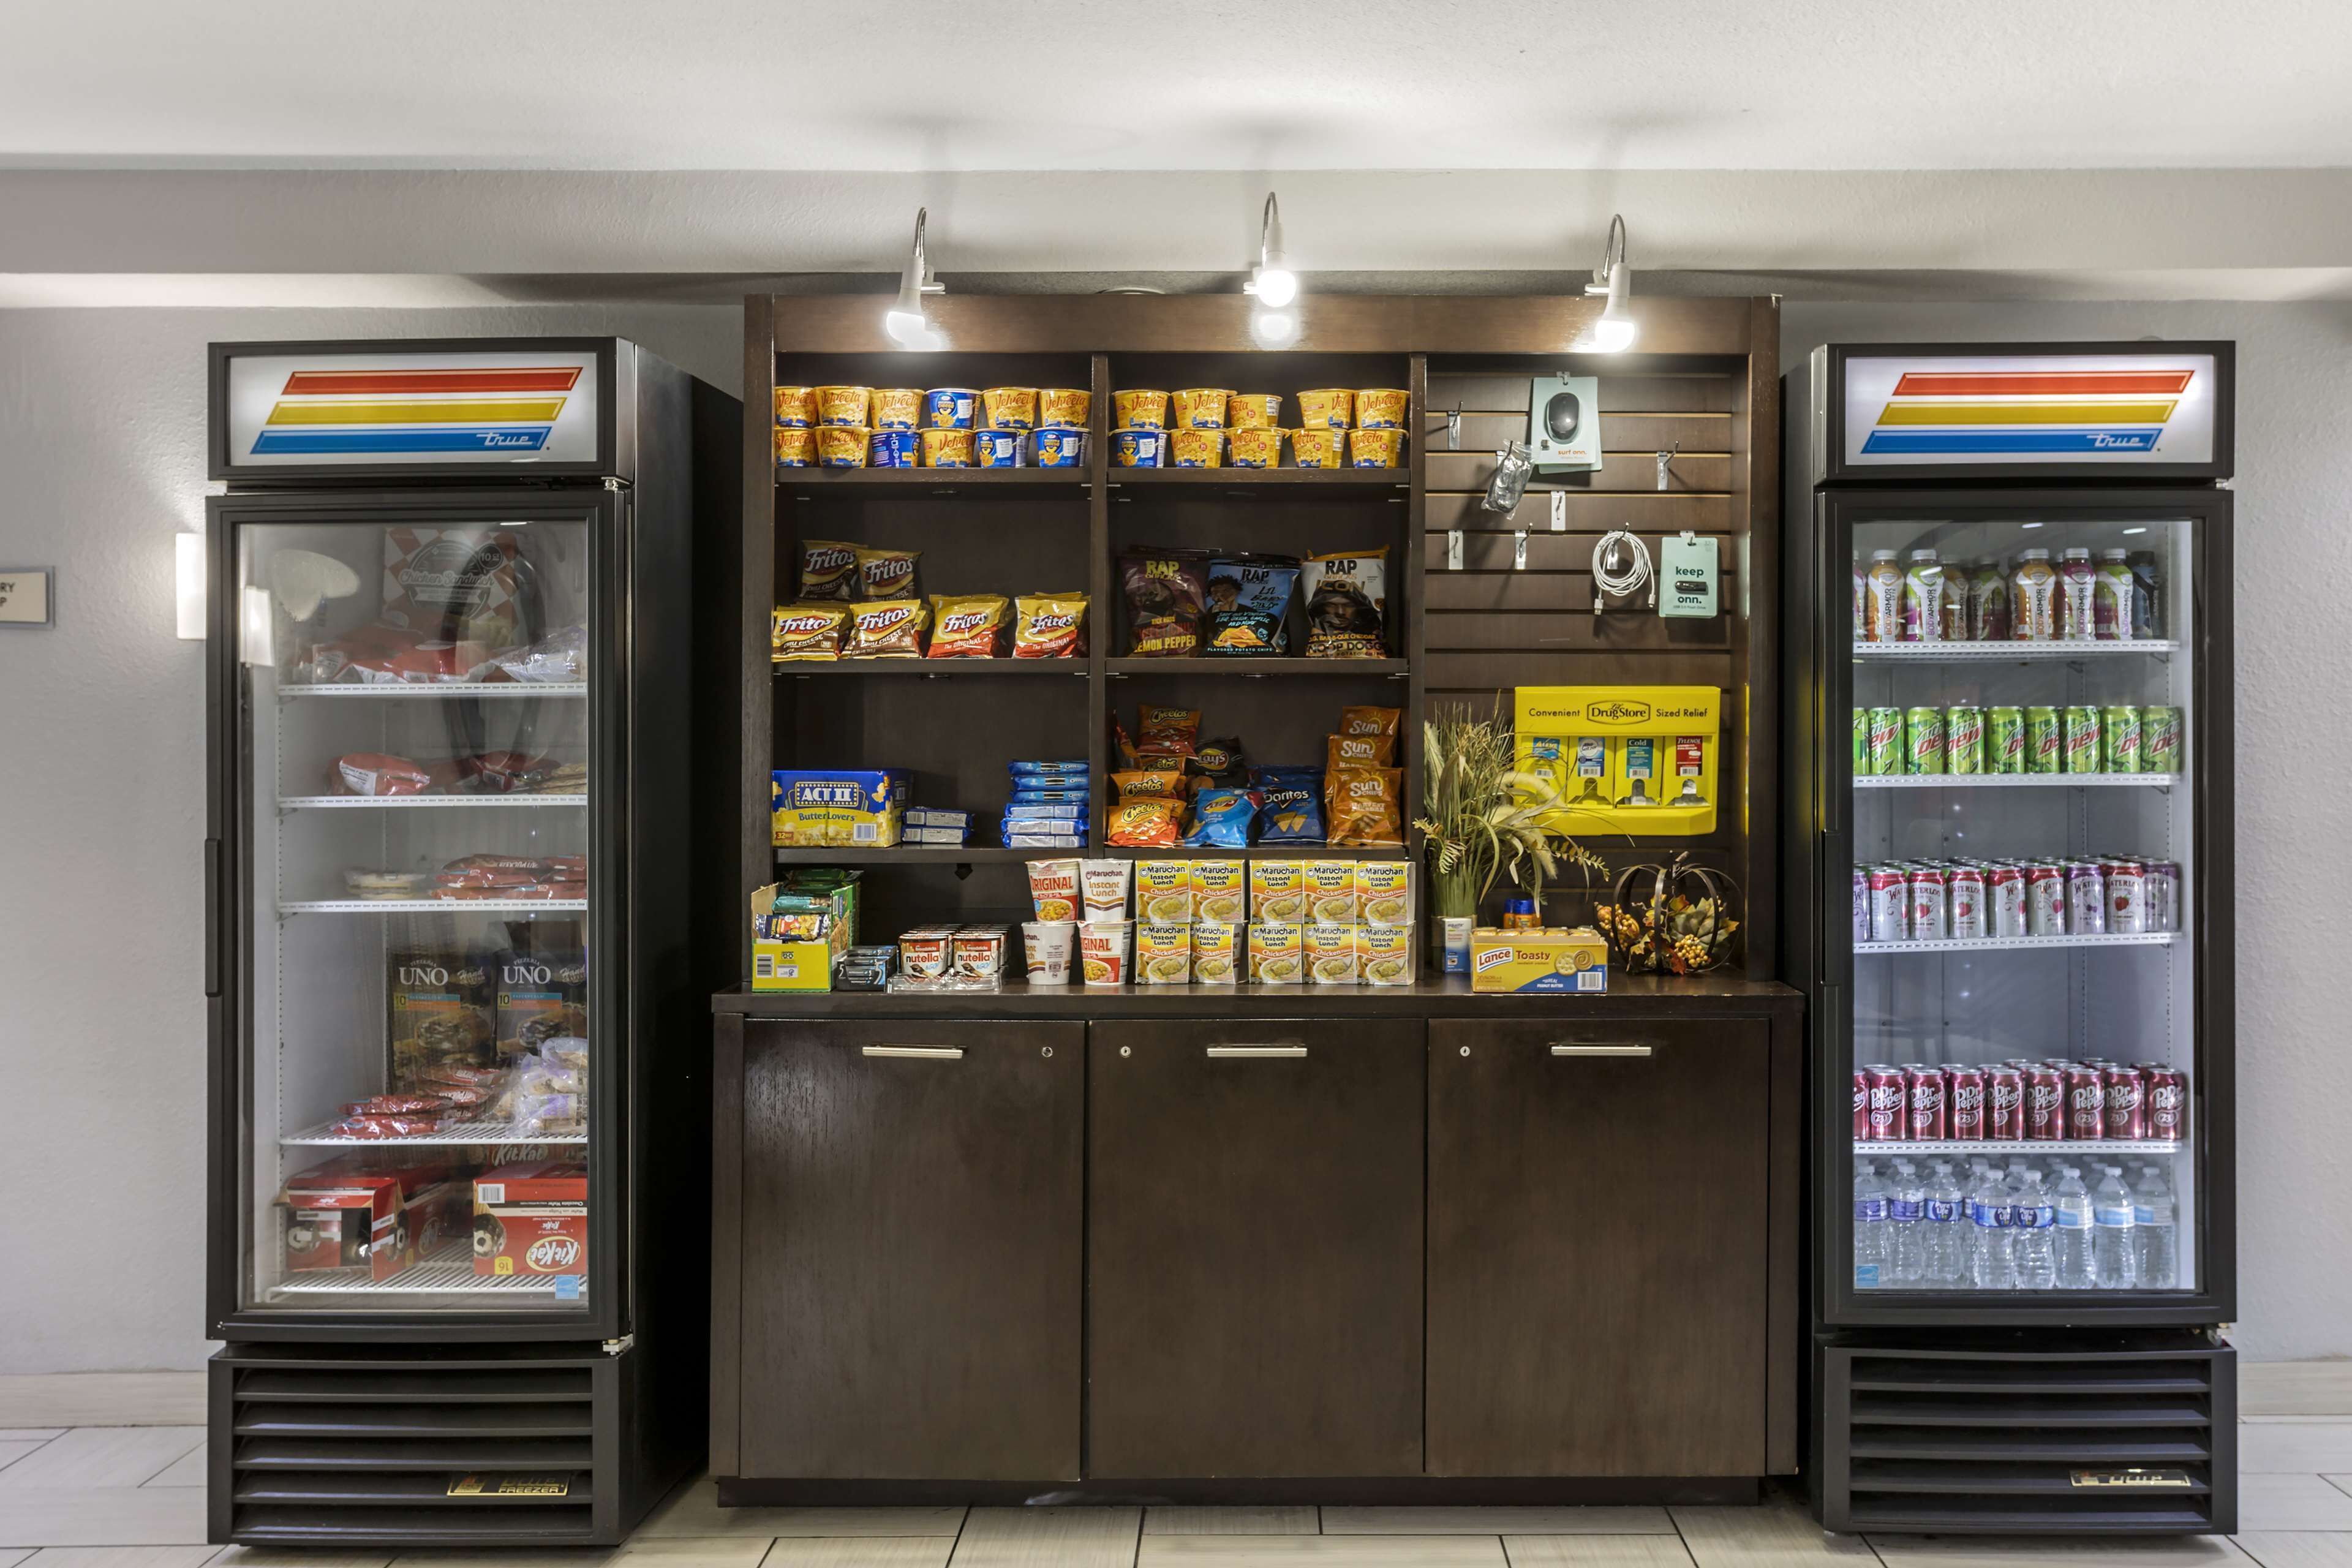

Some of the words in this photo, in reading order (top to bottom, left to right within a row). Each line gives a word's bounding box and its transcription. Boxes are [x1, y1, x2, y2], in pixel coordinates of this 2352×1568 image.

[821, 391, 860, 408] Velveeta
[1046, 393, 1085, 412] Velveeta
[1363, 394, 1403, 413] Velveeta
[481, 552, 490, 561] 10
[805, 548, 855, 572] Fritos
[863, 559, 913, 583] Fritos
[1146, 560, 1179, 575] RAP
[1325, 560, 1357, 575] RAP
[1676, 566, 1704, 578] keep
[400, 569, 442, 584] Chicken
[443, 570, 495, 587] Sandwich
[1242, 569, 1269, 581] RAP
[2036, 588, 2045, 636] BODYARMOR
[2077, 587, 2086, 635] BODYARMOR
[858, 608, 911, 630] Fritos
[944, 612, 988, 633] Fritos
[1030, 614, 1074, 634] Fritos
[779, 617, 832, 635] Fritos
[800, 633, 824, 645] CHEESE
[879, 628, 903, 644] CHEESE
[1165, 635, 1196, 649] PEPPER
[953, 638, 981, 649] ORIGINAL
[1042, 638, 1069, 649] ORIGINAL
[1150, 709, 1189, 724] Cheetos
[1529, 708, 1580, 717] Convenient
[1683, 708, 1708, 717] Relief
[1349, 720, 1379, 734] Sun
[1341, 741, 1374, 757] Sun
[1123, 779, 1164, 796] Cheetos
[1350, 781, 1383, 797] Sun
[802, 788, 832, 801] ACT
[1264, 790, 1309, 803] Doritos
[798, 812, 855, 821] ButterLovers
[1122, 803, 1164, 824] Cheetos
[1317, 888, 1342, 897] Chicken
[1368, 889, 1393, 898] Chicken
[1195, 927, 1229, 935] Maruchan
[906, 952, 939, 963] nutella
[957, 952, 990, 962] nutella
[1262, 948, 1287, 957] Chicken
[1316, 948, 1341, 957] Chicken
[1368, 950, 1393, 959] Chicken
[1479, 949, 1510, 966] Lance
[1516, 950, 1550, 960] Toasty
[399, 967, 448, 986] UNO
[502, 966, 551, 985] UNO
[395, 995, 406, 1005] 10
[499, 994, 510, 1005] 10
[1881, 1086, 1896, 1099] Dr
[1920, 1087, 1935, 1098] Dr
[1966, 1087, 1980, 1098] Dr
[1995, 1086, 2011, 1098] Dr
[2035, 1086, 2051, 1097] Dr
[2115, 1086, 2131, 1097] Dr
[1871, 1087, 1902, 1110] Pepper
[494, 1145, 543, 1166] KitKat
[530, 1241, 578, 1265] KitKat
[499, 1262, 510, 1272] 16
